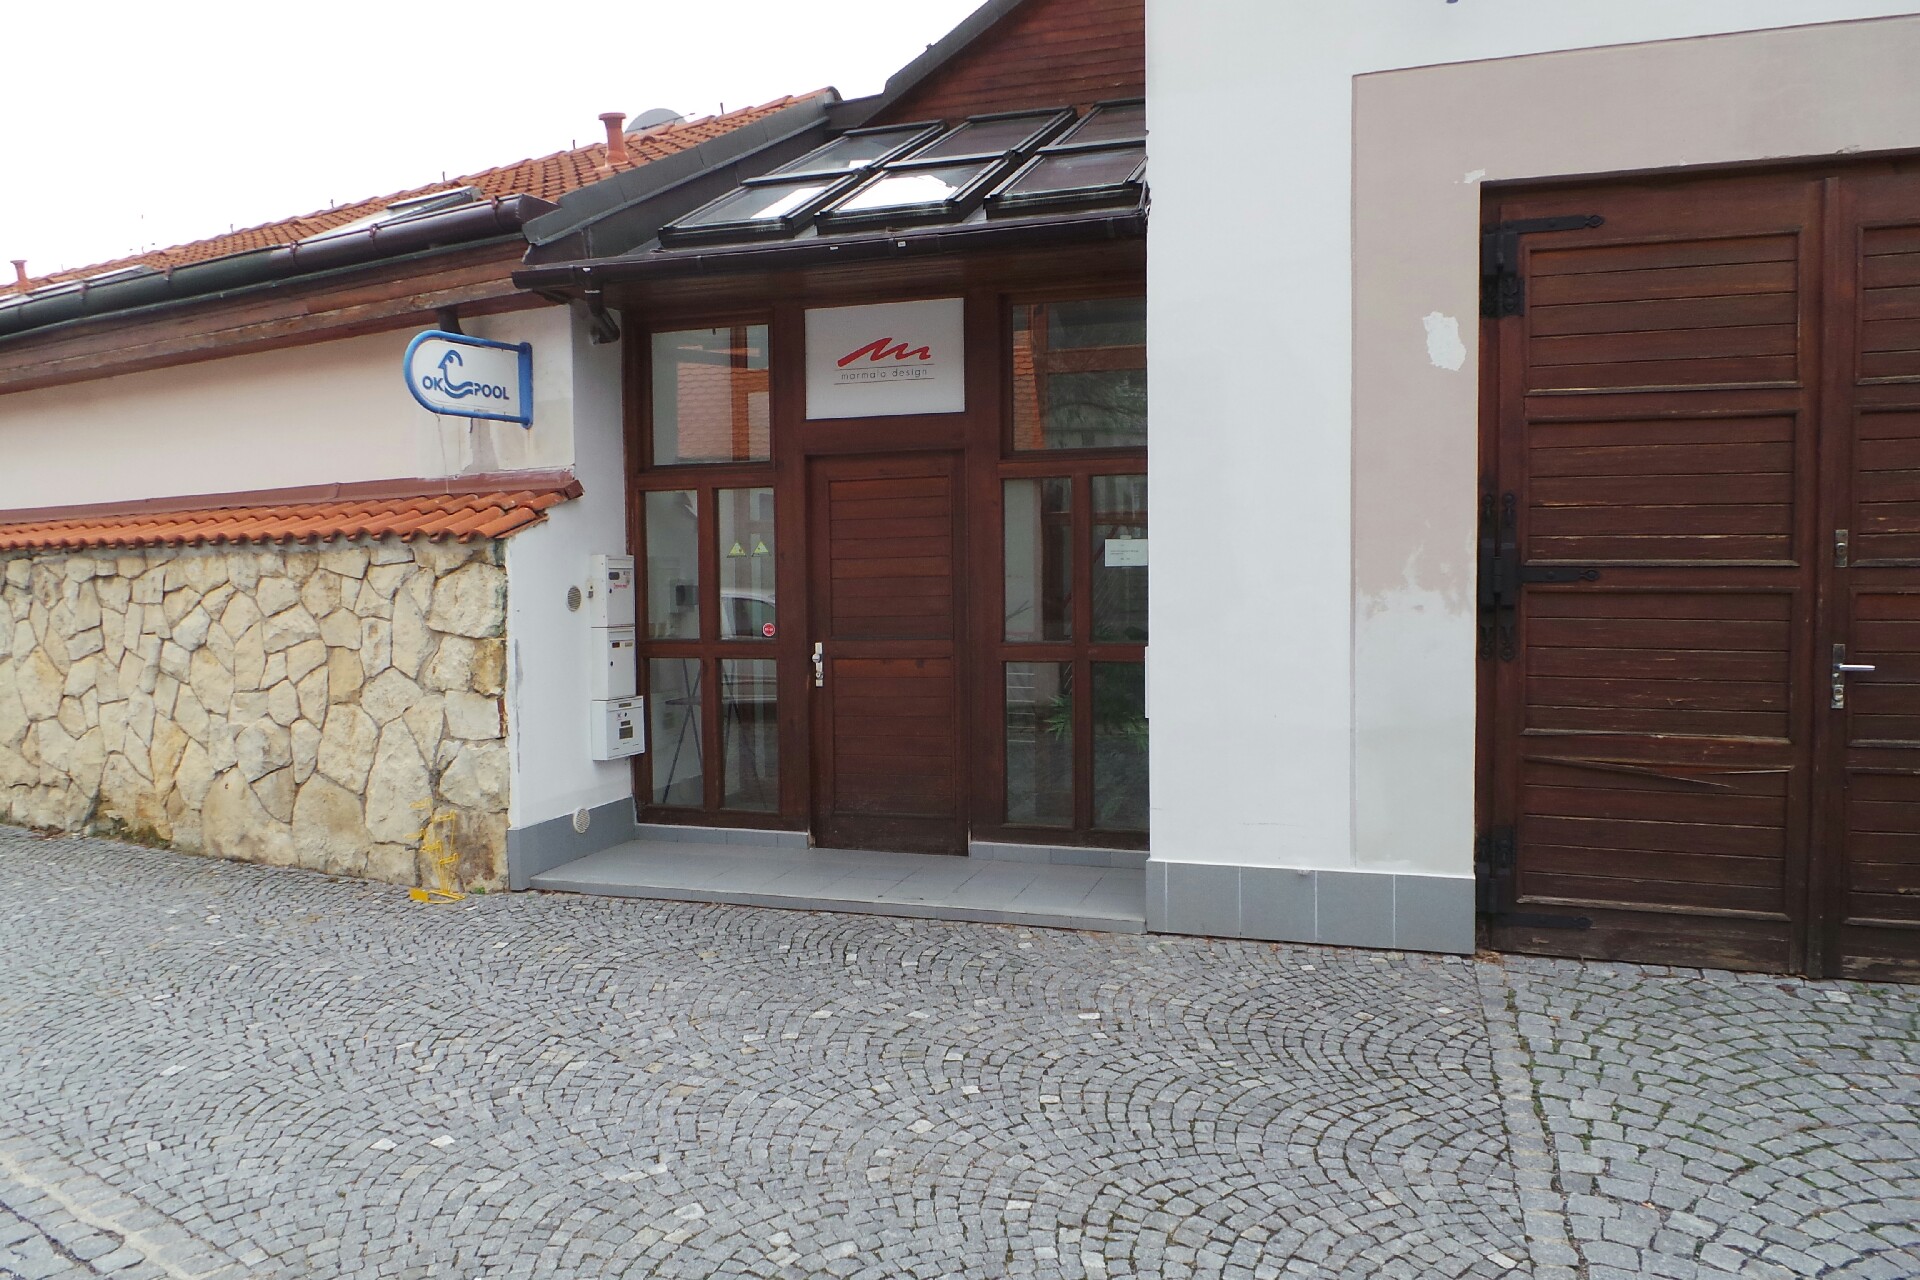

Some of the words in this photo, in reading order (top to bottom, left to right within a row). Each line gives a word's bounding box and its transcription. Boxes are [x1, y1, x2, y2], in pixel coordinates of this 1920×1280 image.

[891, 368, 927, 378] design
[422, 375, 445, 392] OK
[474, 382, 510, 400] POOL
